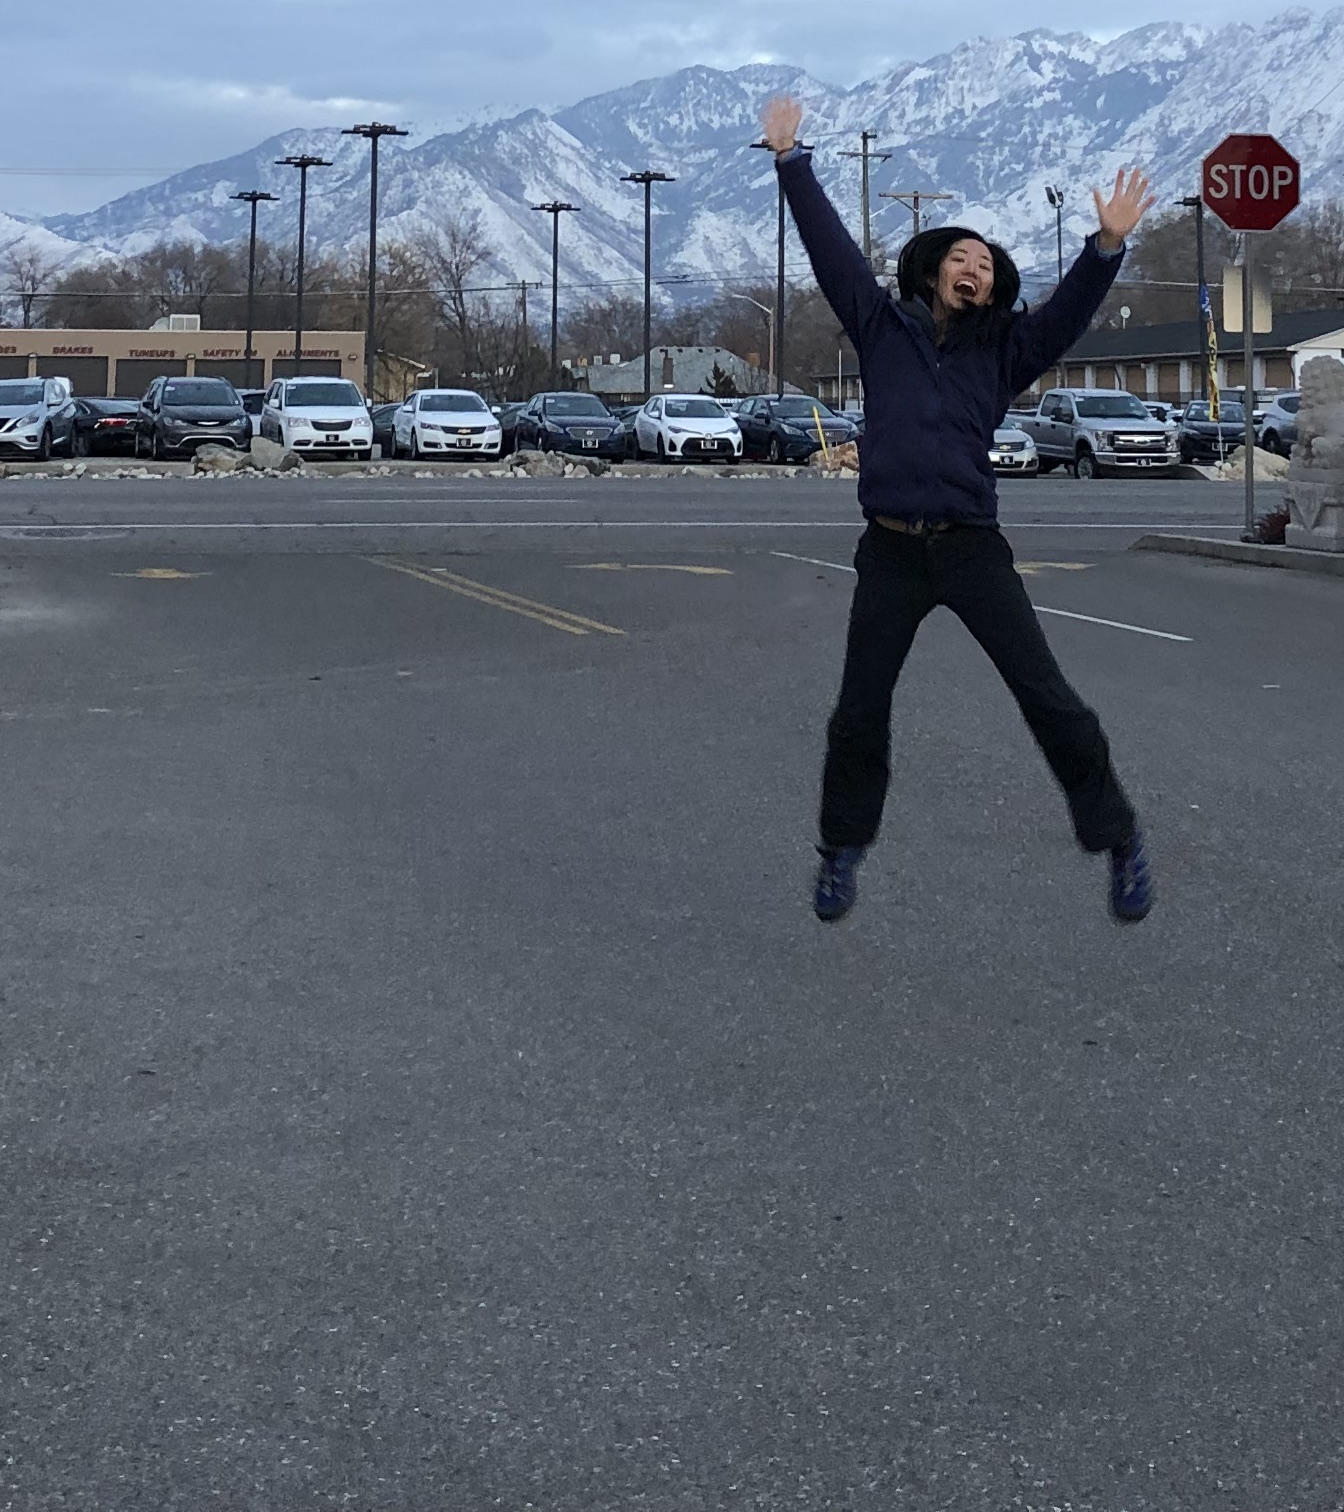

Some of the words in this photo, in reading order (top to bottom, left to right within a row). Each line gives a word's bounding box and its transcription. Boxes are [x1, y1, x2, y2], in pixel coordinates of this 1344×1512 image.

[1208, 163, 1294, 200] STOP
[52, 346, 94, 355] BRAKES
[128, 349, 176, 358] TUNEUPS
[202, 349, 241, 357] SAFETY
